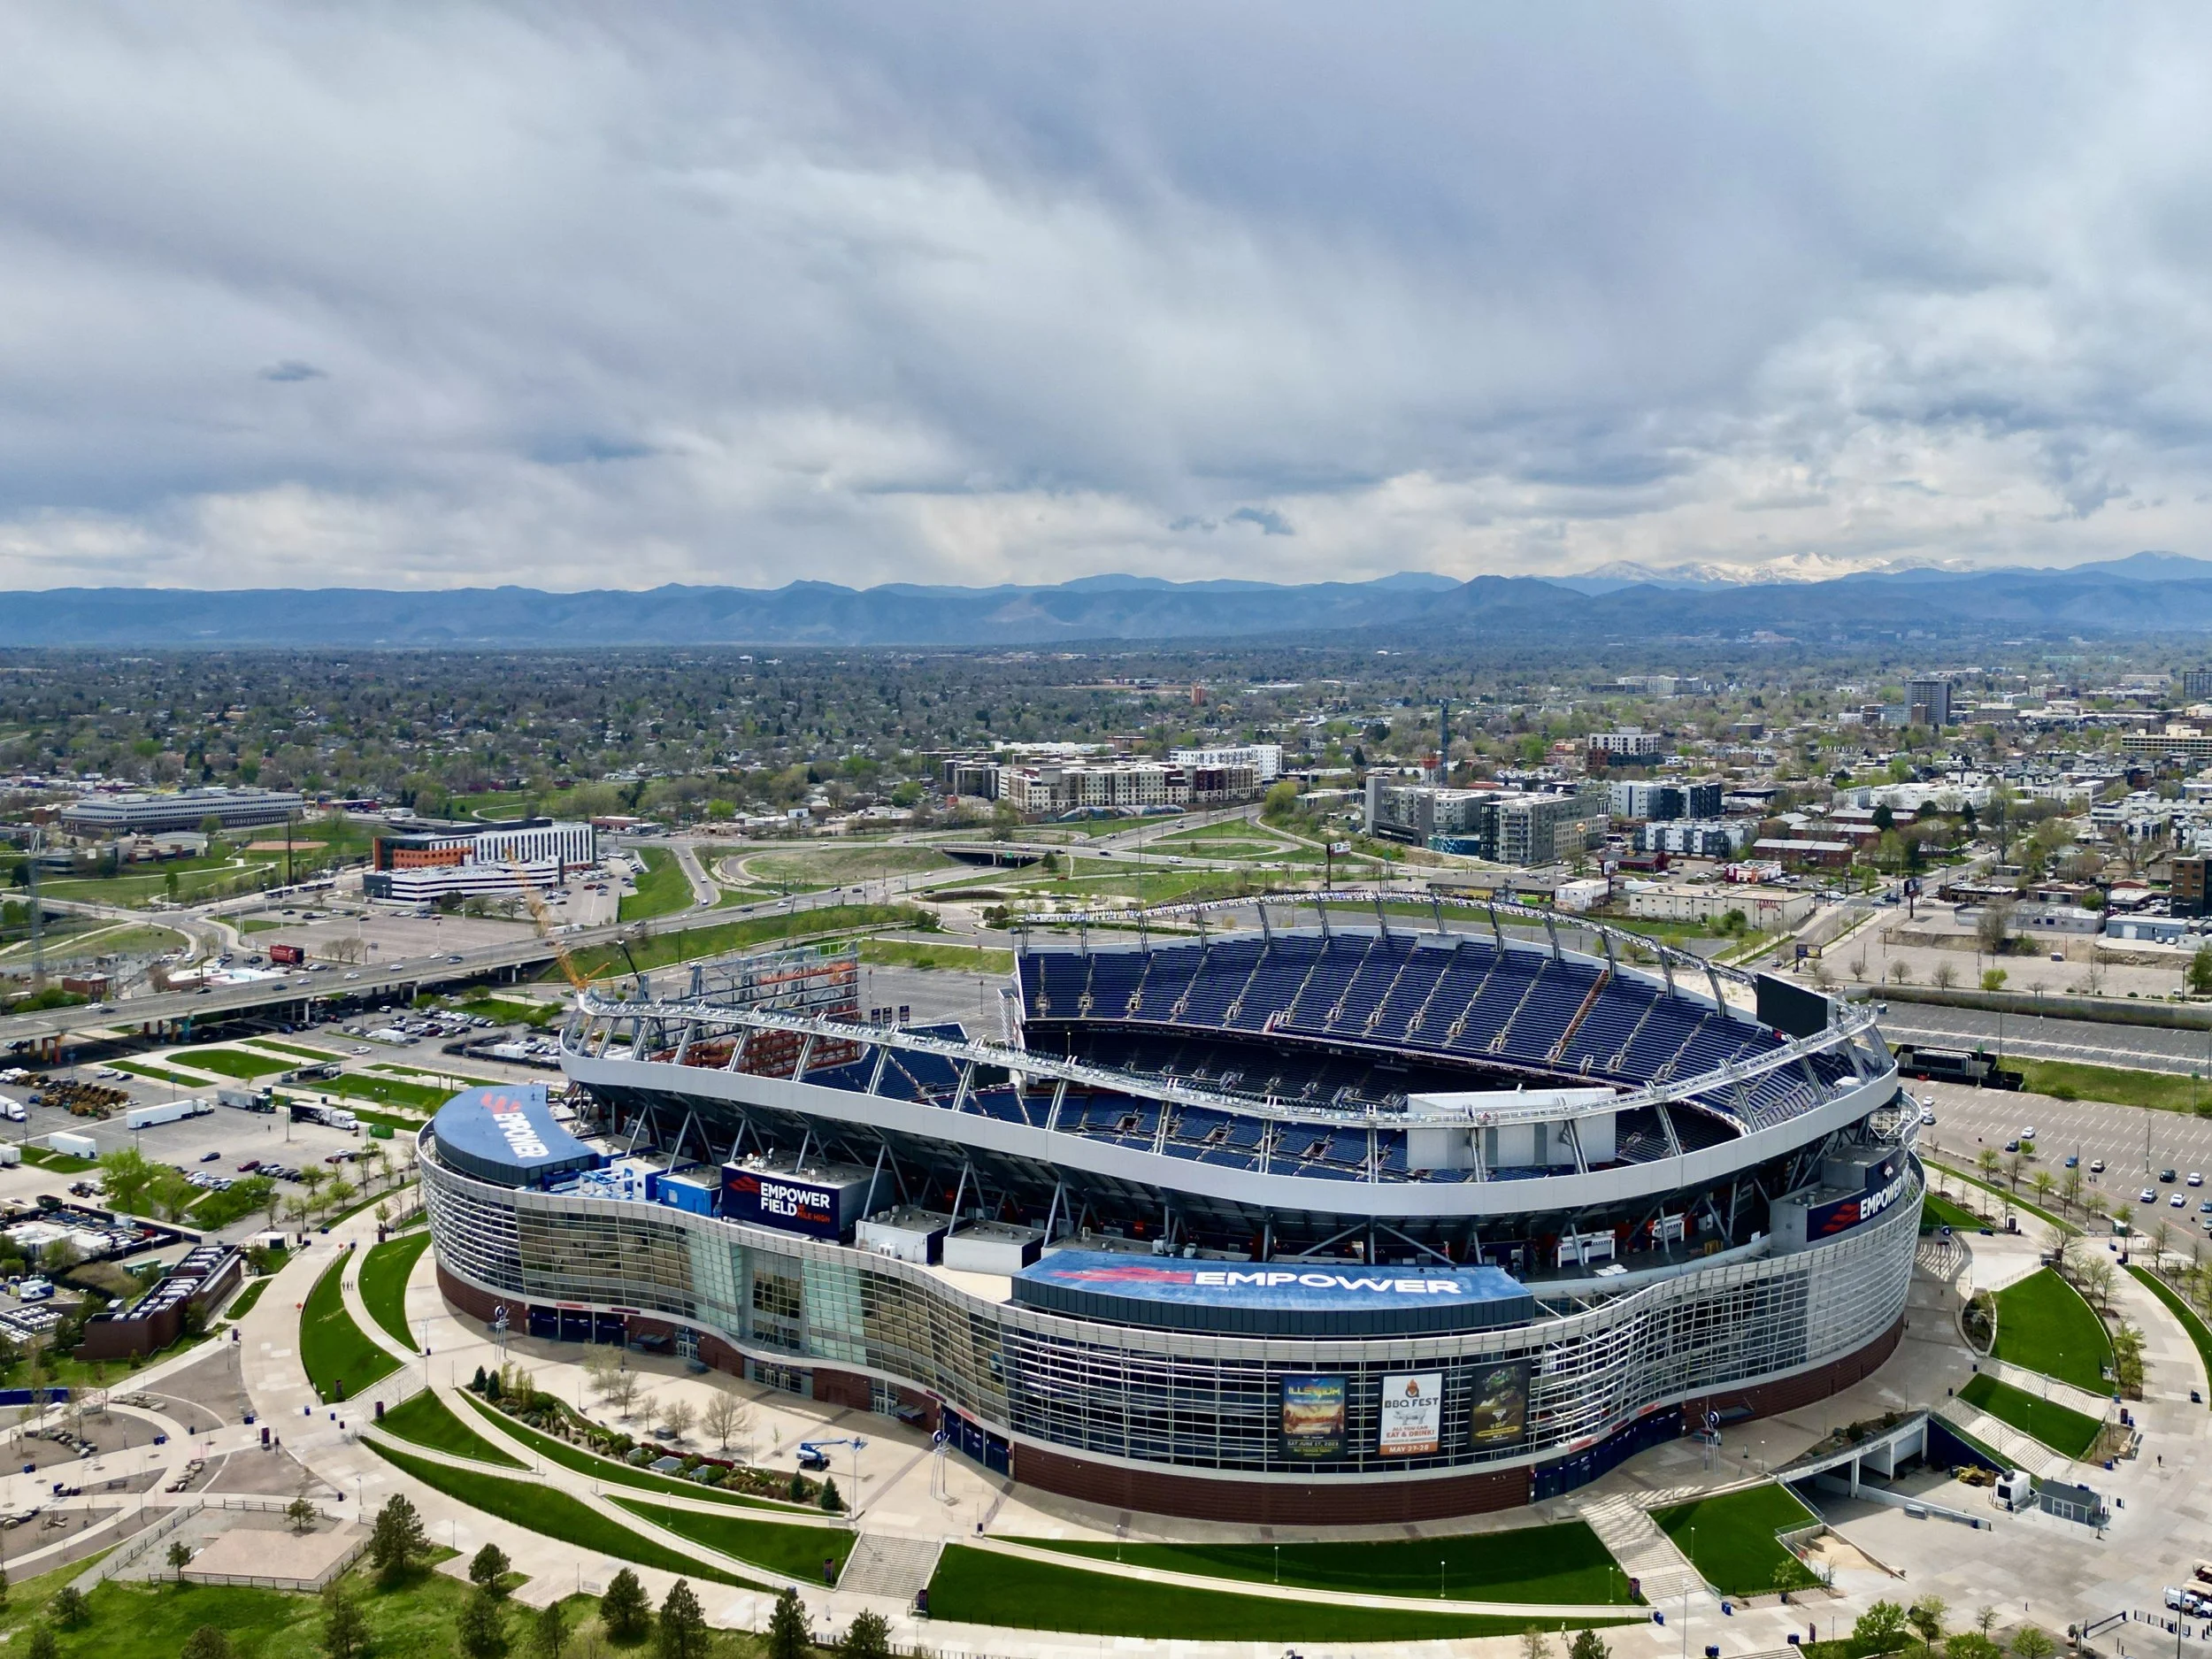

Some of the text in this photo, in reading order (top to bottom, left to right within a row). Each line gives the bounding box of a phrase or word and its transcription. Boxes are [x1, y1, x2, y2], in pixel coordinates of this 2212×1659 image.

[492, 1112, 550, 1158] EMPOWER
[761, 1182, 830, 1209] EMPOWER
[761, 1197, 797, 1216] FIELD
[1860, 1175, 1902, 1220] EMPOWER
[813, 1214, 830, 1223] HIGH
[1194, 1271, 1462, 1294] EMPOWER
[1384, 1397, 1439, 1409] BBQ FEST
